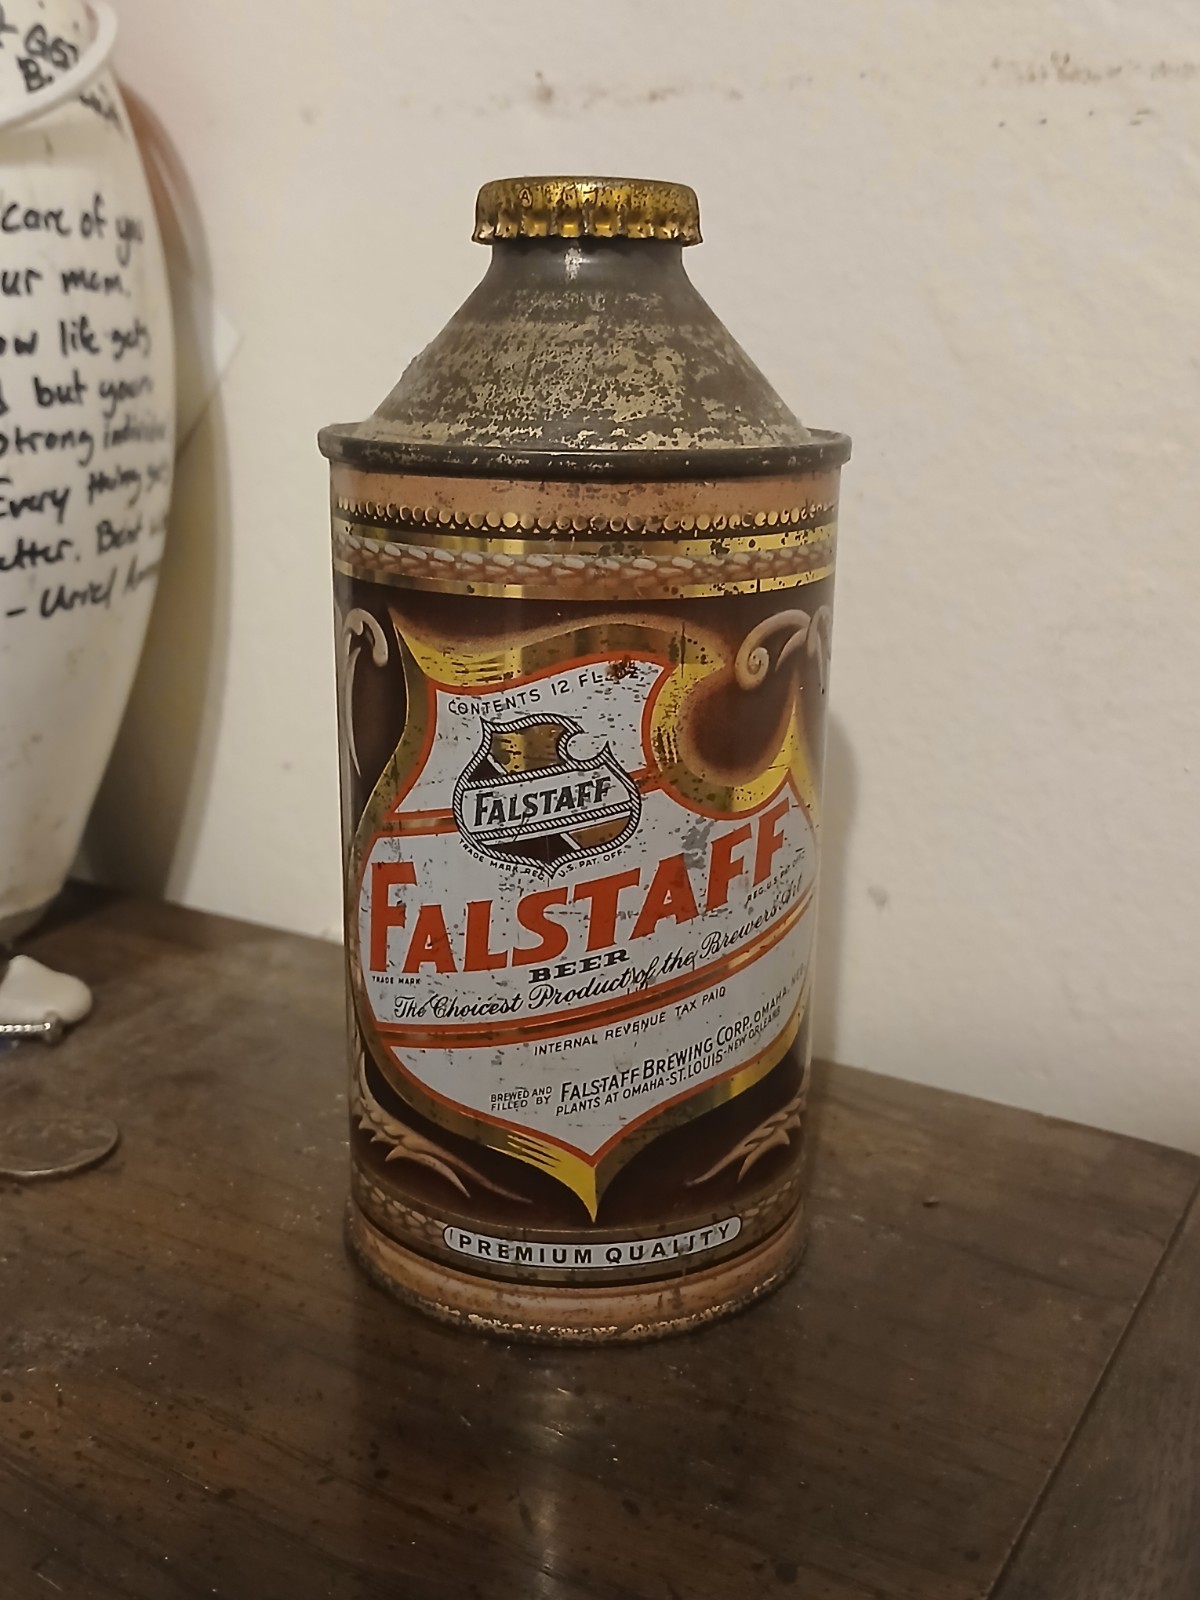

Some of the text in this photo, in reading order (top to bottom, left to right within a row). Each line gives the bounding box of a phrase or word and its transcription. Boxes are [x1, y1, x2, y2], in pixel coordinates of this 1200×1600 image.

[81, 194, 107, 240] of
[33, 368, 87, 409] but
[448, 689, 541, 715] CONTENTS
[551, 680, 570, 696] 12
[473, 776, 612, 827] FALSTAFF
[459, 838, 485, 863] TRADE
[490, 860, 518, 874] MARK
[558, 863, 577, 878] U.S.
[579, 857, 600, 868] PAT.
[603, 848, 626, 862] OFF.
[370, 797, 790, 974] FALSTAFF
[372, 975, 421, 985] TRADE MARK
[394, 995, 428, 1018] The
[429, 992, 523, 1019] Choicest
[528, 967, 633, 1010] Product
[635, 956, 660, 990] of
[659, 946, 698, 976] the
[528, 949, 630, 984] BEER
[534, 986, 726, 1056] INTERNAL REVENUE TAX PAID
[561, 1067, 639, 1103] FALSTAFF
[643, 1037, 713, 1080] BREWING
[491, 1086, 552, 1103] BREWED AND
[491, 1095, 551, 1111] FILLED BY
[556, 1097, 600, 1116] PLANTS
[605, 1092, 619, 1104] AT
[459, 1222, 731, 1264] PREMIUM QUALITY
